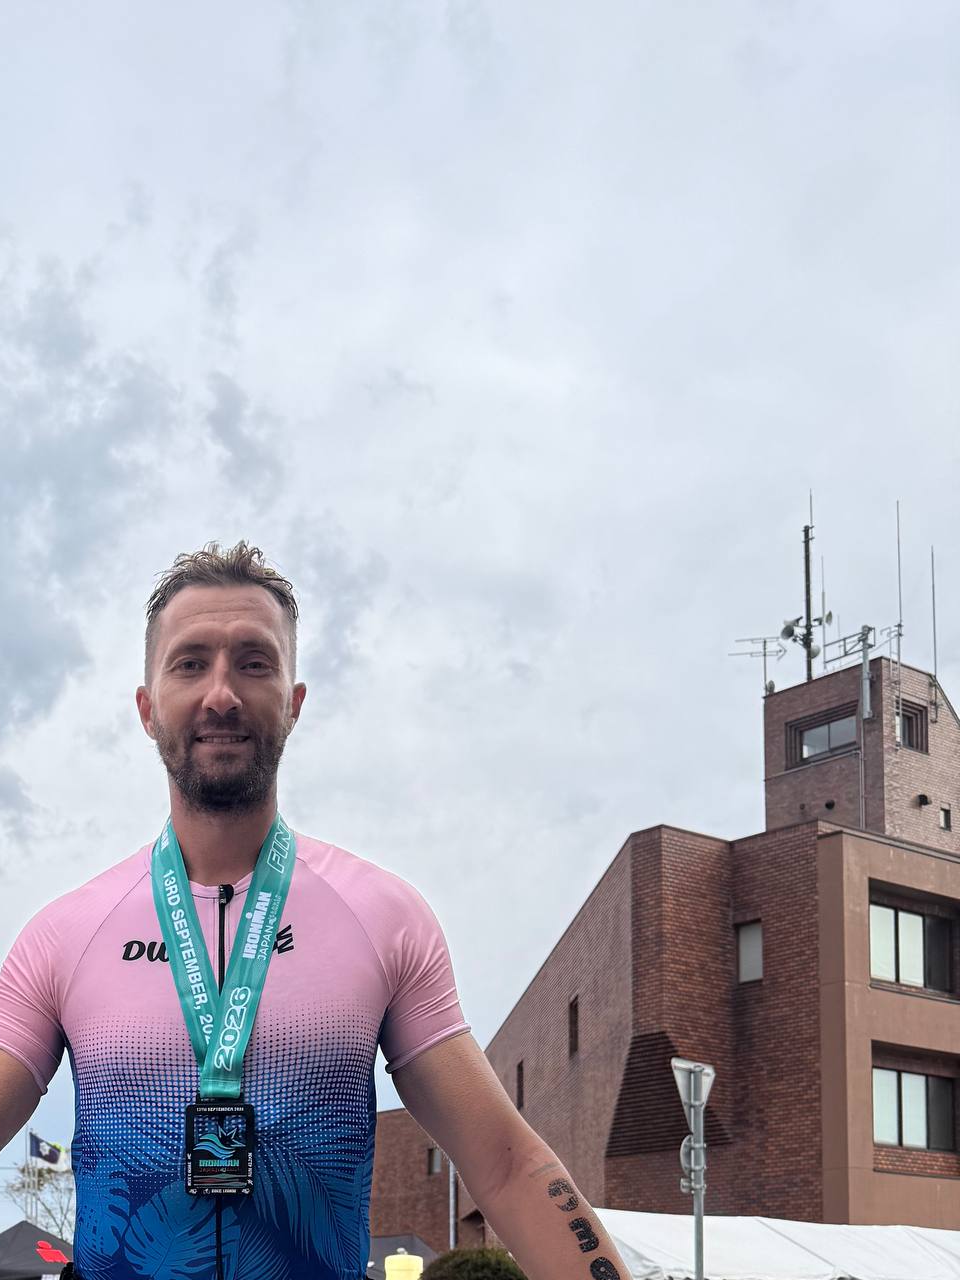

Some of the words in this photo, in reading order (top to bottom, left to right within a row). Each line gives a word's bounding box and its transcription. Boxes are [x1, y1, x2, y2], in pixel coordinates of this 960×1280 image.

[163, 869, 182, 906] 13RD
[242, 891, 272, 959] IRONMAN
[257, 926, 276, 961] JAPAN
[171, 909, 209, 1010] SEPTEMBER,
[214, 986, 252, 1071] 2026
